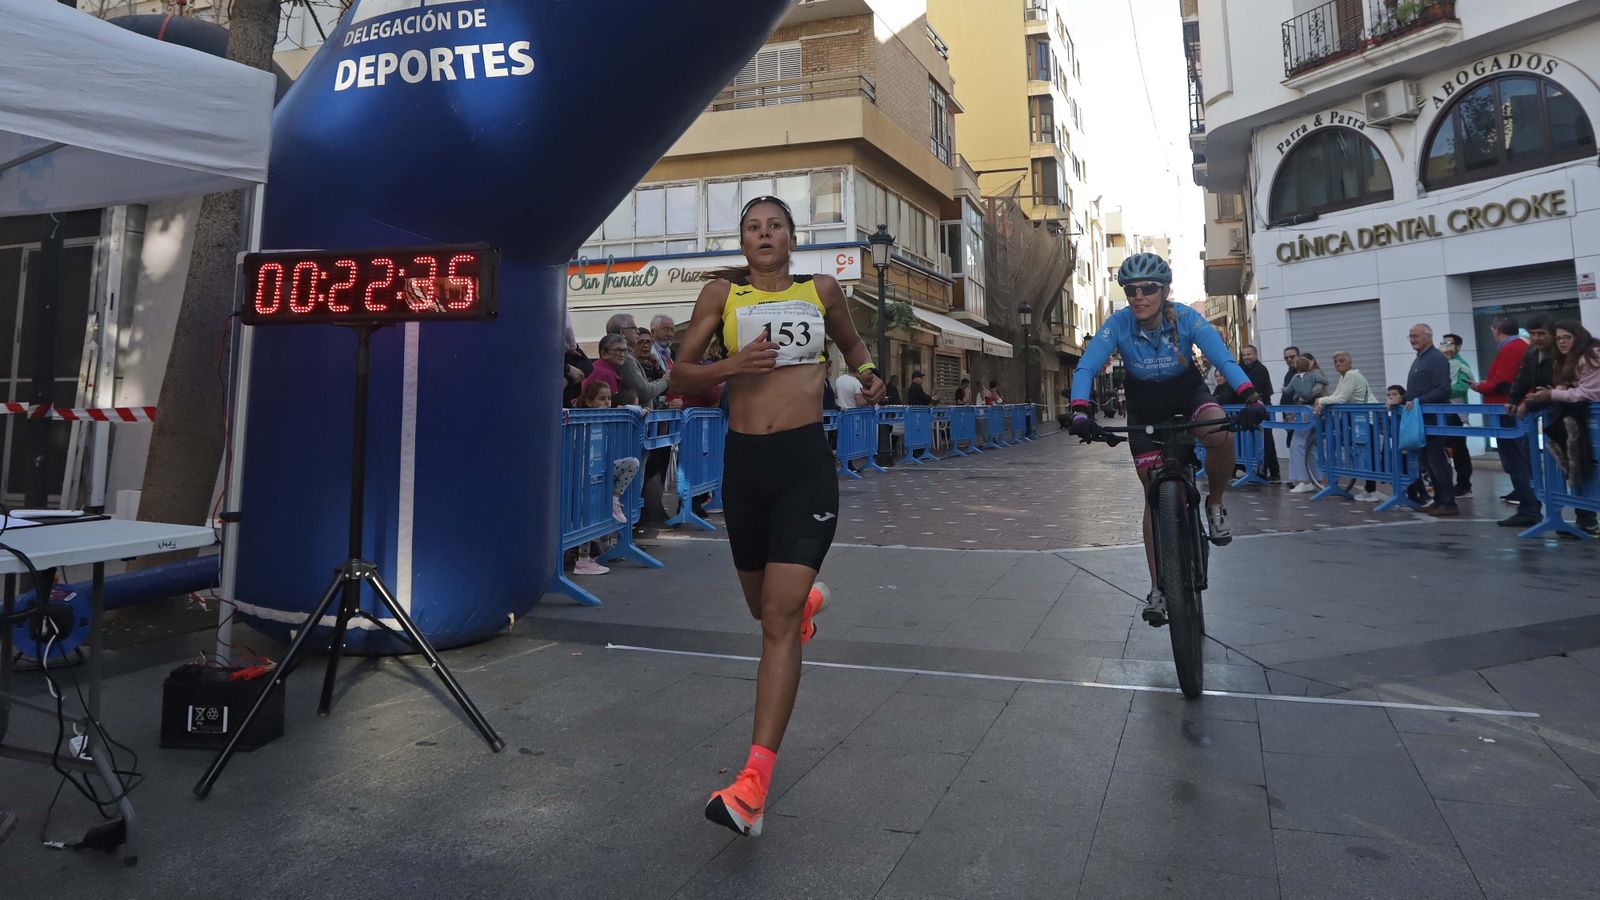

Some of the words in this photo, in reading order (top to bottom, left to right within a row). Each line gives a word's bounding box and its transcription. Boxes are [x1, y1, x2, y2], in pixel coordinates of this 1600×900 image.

[343, 10, 451, 47] DELEGACIÓN
[457, 8, 487, 29] DE
[334, 41, 535, 91] DEPORTES
[1432, 53, 1559, 110] ABOGADOS
[1277, 123, 1308, 156] Parra
[1313, 114, 1323, 127] &
[1330, 111, 1366, 131] Parra
[1276, 229, 1355, 263] CLÍNICA
[1358, 214, 1443, 250] DENTAL
[1447, 189, 1568, 234] CROOKE
[836, 253, 855, 266] Cs
[255, 254, 474, 314] 00:22:35
[762, 321, 811, 347] 153
